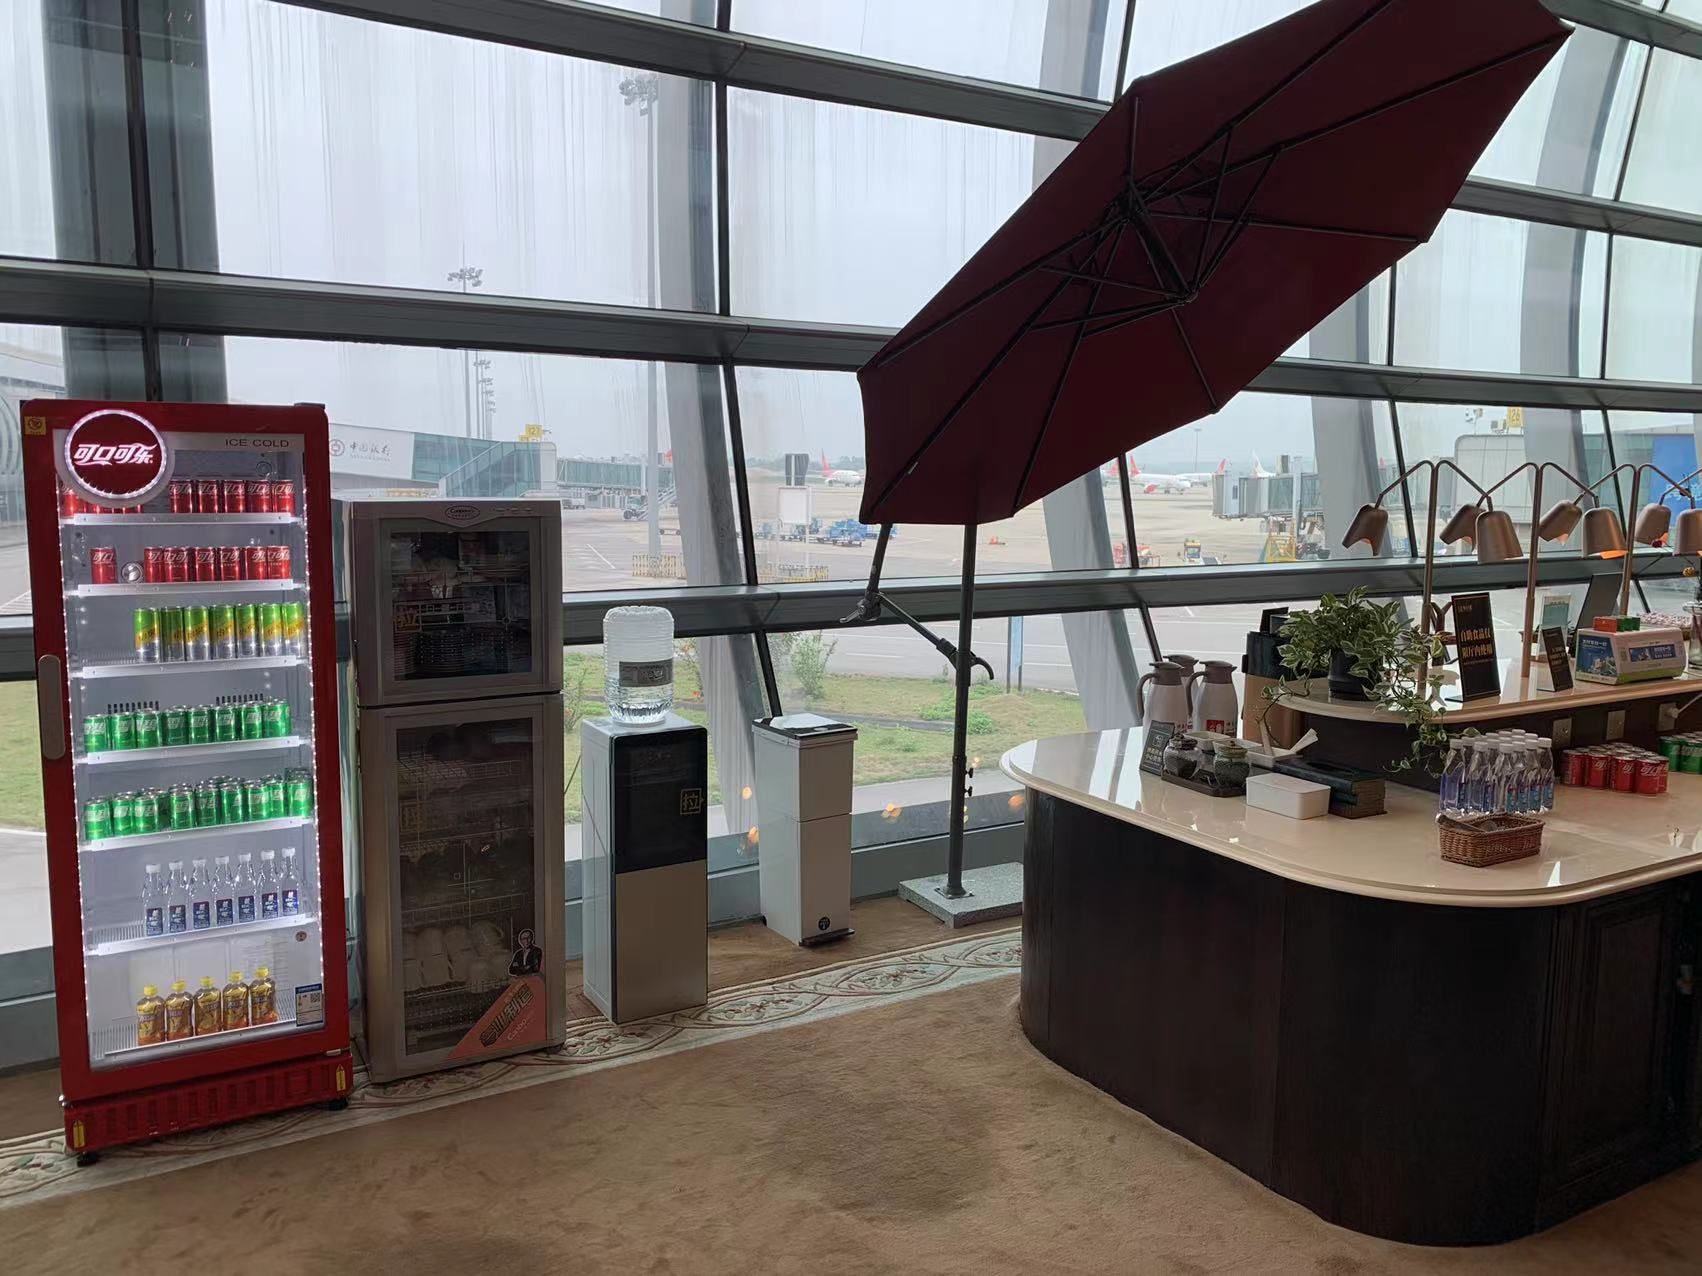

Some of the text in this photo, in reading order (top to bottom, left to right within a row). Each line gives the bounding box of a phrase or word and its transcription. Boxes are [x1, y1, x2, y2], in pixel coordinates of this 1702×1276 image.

[226, 438, 289, 448] ICE COLD
[74, 442, 158, 466] 可口可乐
